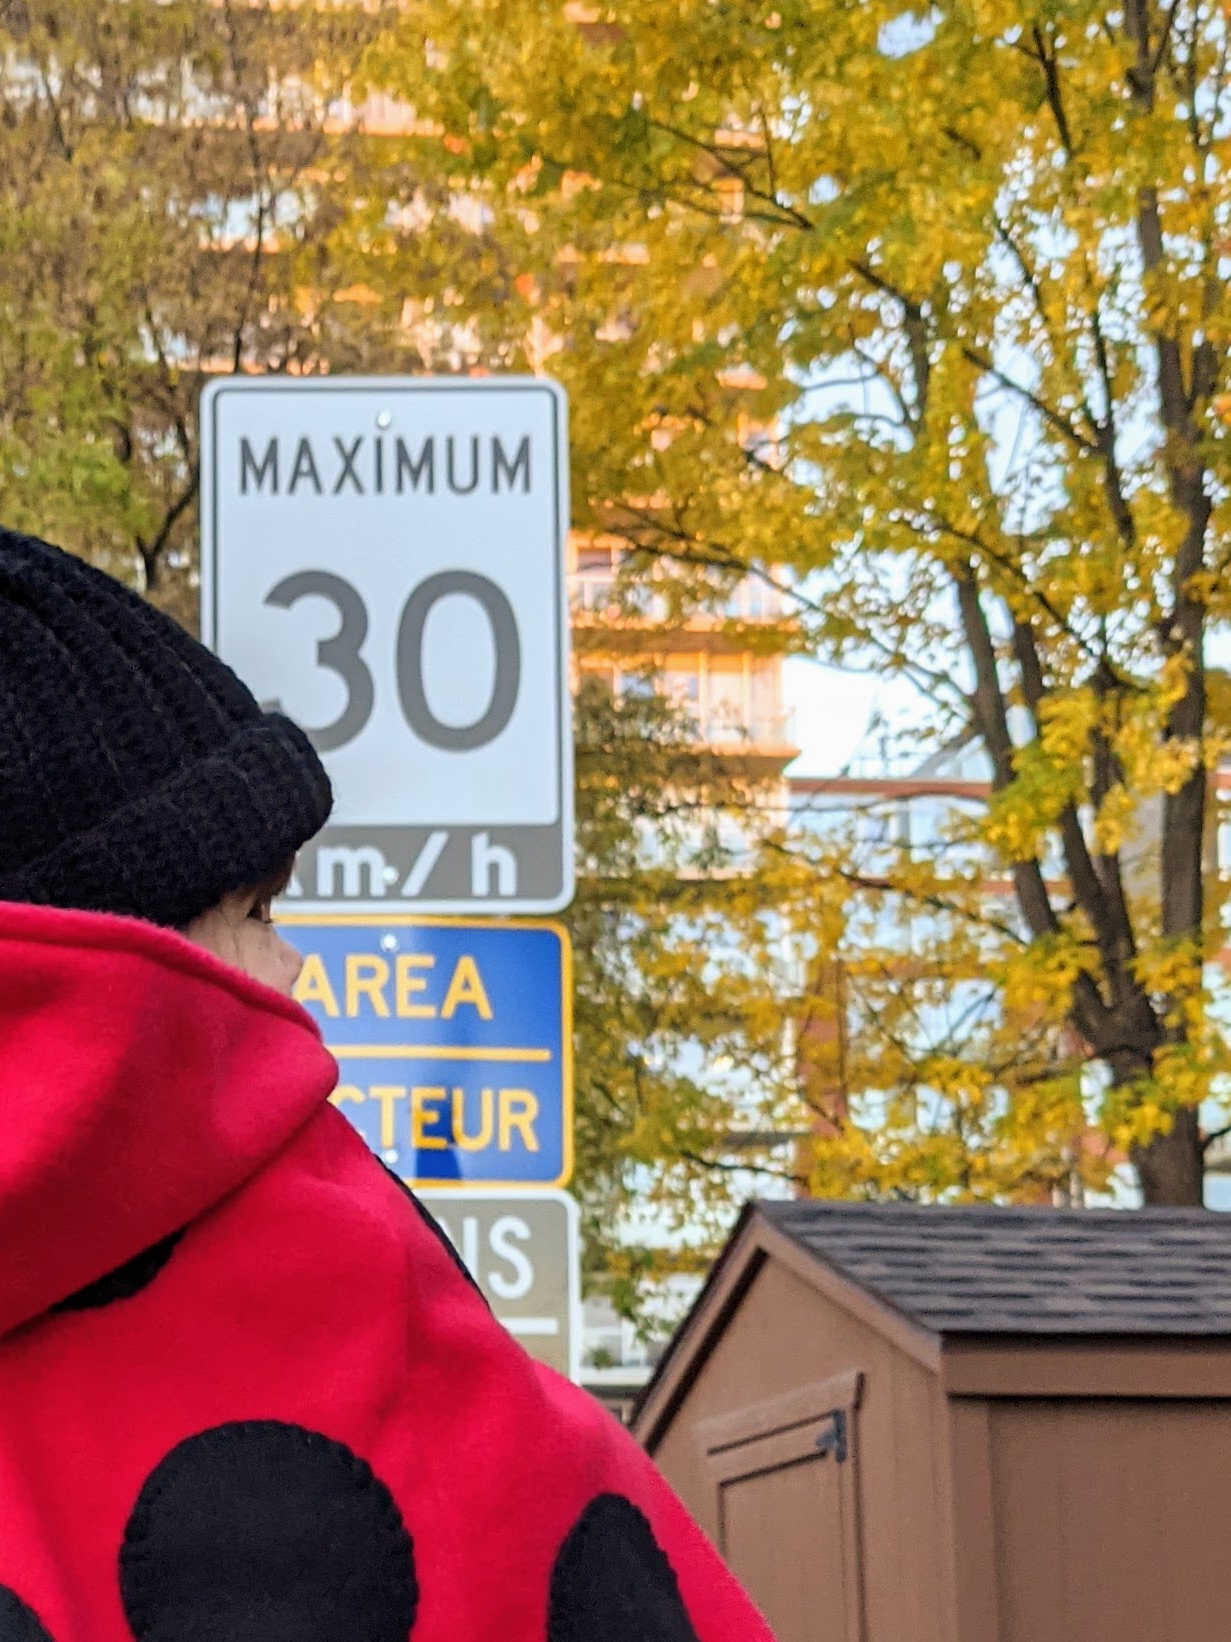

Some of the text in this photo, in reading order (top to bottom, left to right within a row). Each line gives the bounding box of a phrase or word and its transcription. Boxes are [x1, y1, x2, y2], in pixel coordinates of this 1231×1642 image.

[239, 435, 531, 495] MAXIMUM
[264, 568, 521, 753] 30
[293, 954, 494, 1020] AREA
